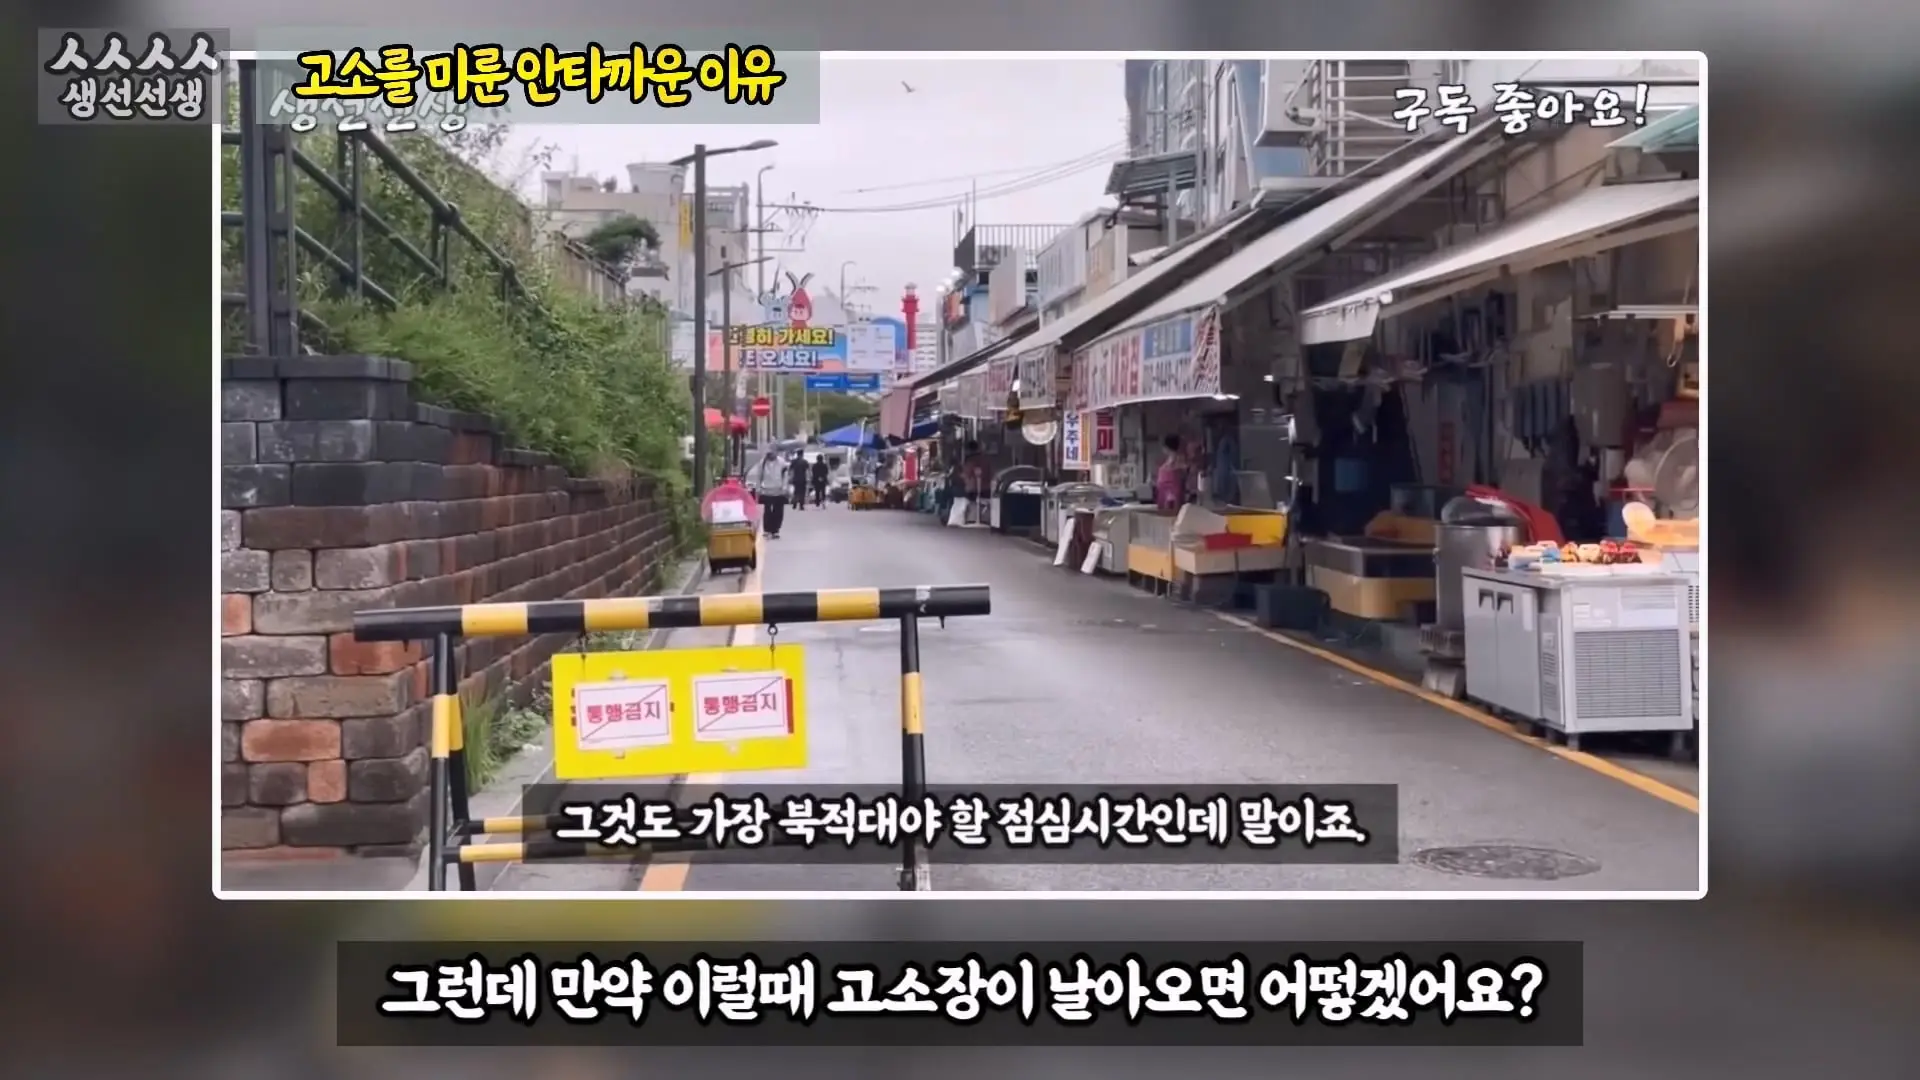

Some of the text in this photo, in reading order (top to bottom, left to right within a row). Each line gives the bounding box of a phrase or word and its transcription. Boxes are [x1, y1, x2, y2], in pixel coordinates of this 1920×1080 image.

[777, 327, 834, 346] 가세요!
[761, 350, 818, 368] 오세요!
[1065, 412, 1080, 461] 우주네
[586, 700, 661, 725] 통행금지
[701, 691, 776, 716] 통행금지
